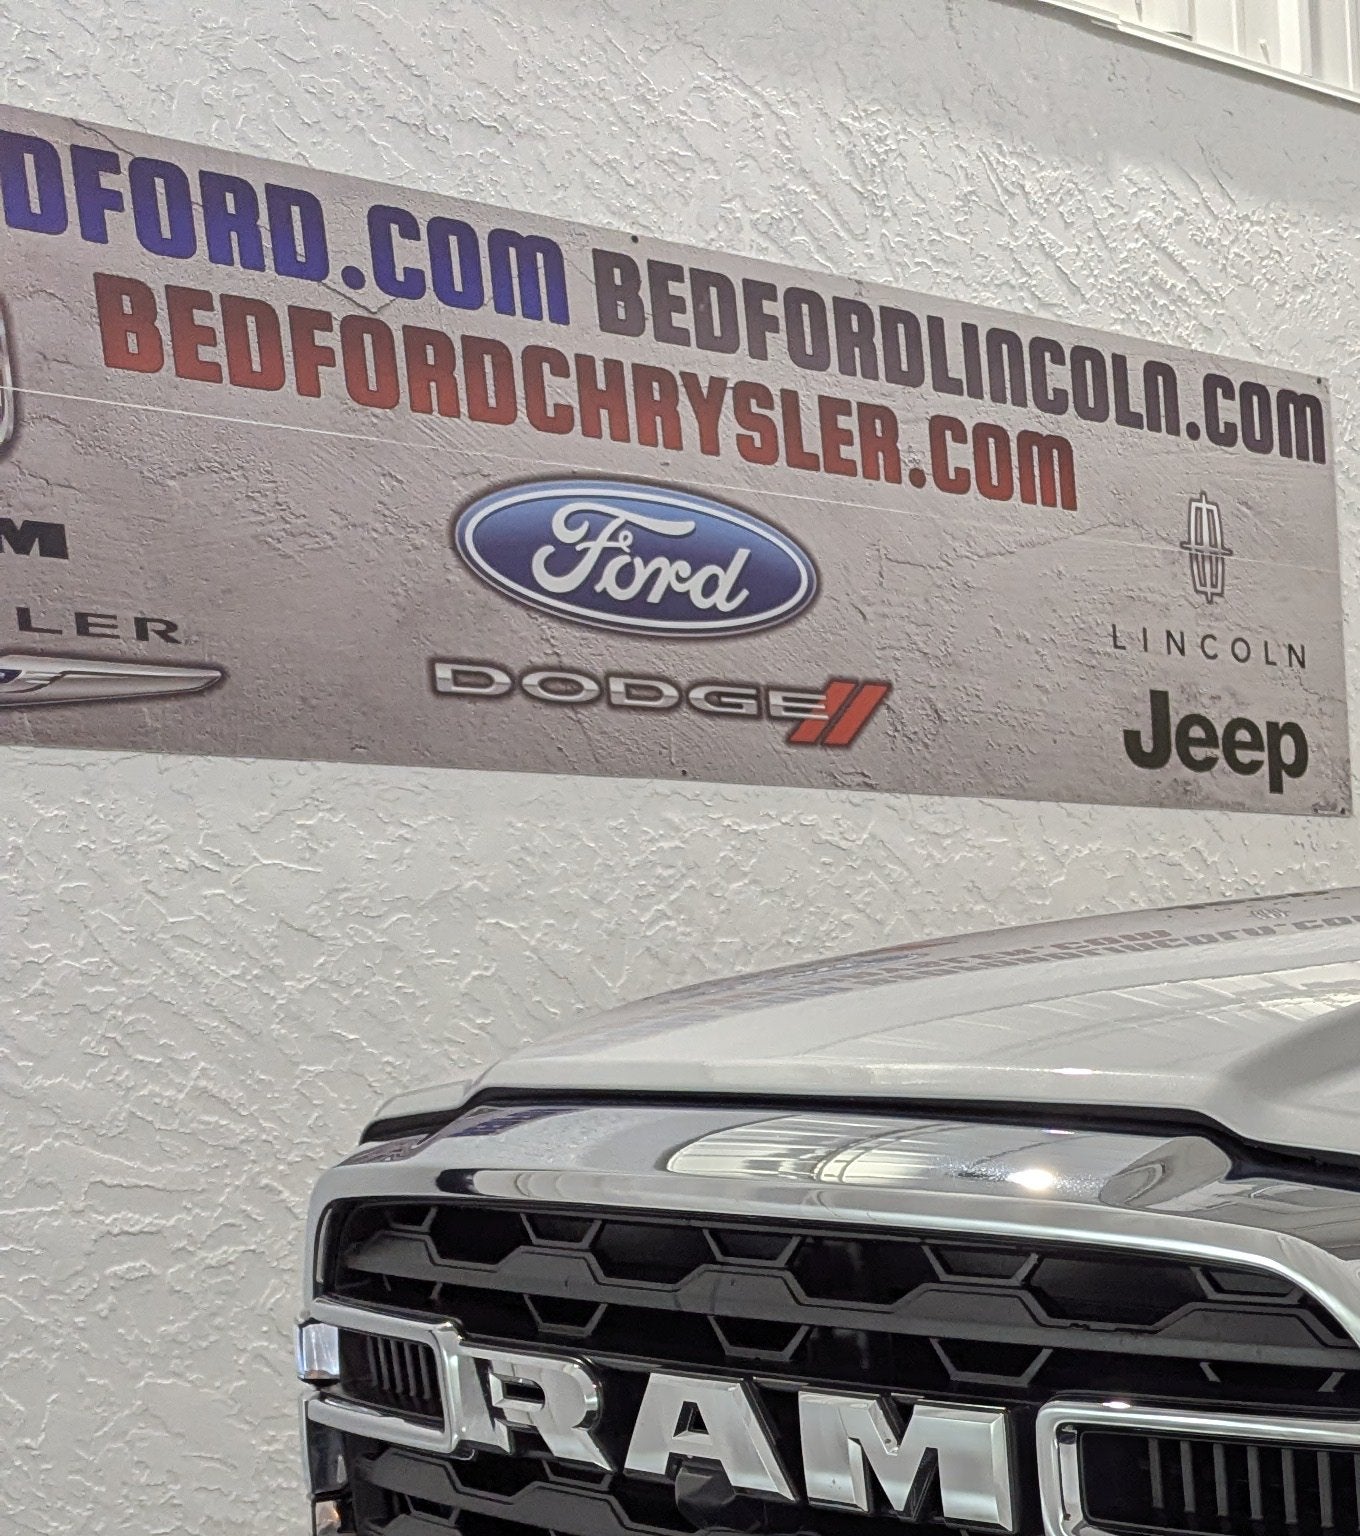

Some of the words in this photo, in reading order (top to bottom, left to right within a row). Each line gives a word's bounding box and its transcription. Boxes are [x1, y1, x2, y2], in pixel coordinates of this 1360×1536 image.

[93, 271, 1078, 512] BEDFORDCHRYSLER.COM
[592, 248, 1327, 465] BEDFORDLINCOLN.COM
[532, 500, 751, 614] Ford
[434, 662, 827, 722] DODGE
[1111, 623, 1306, 669] LINCOLN
[1122, 688, 1309, 795] Jeep
[457, 1340, 1018, 1533] RAM
